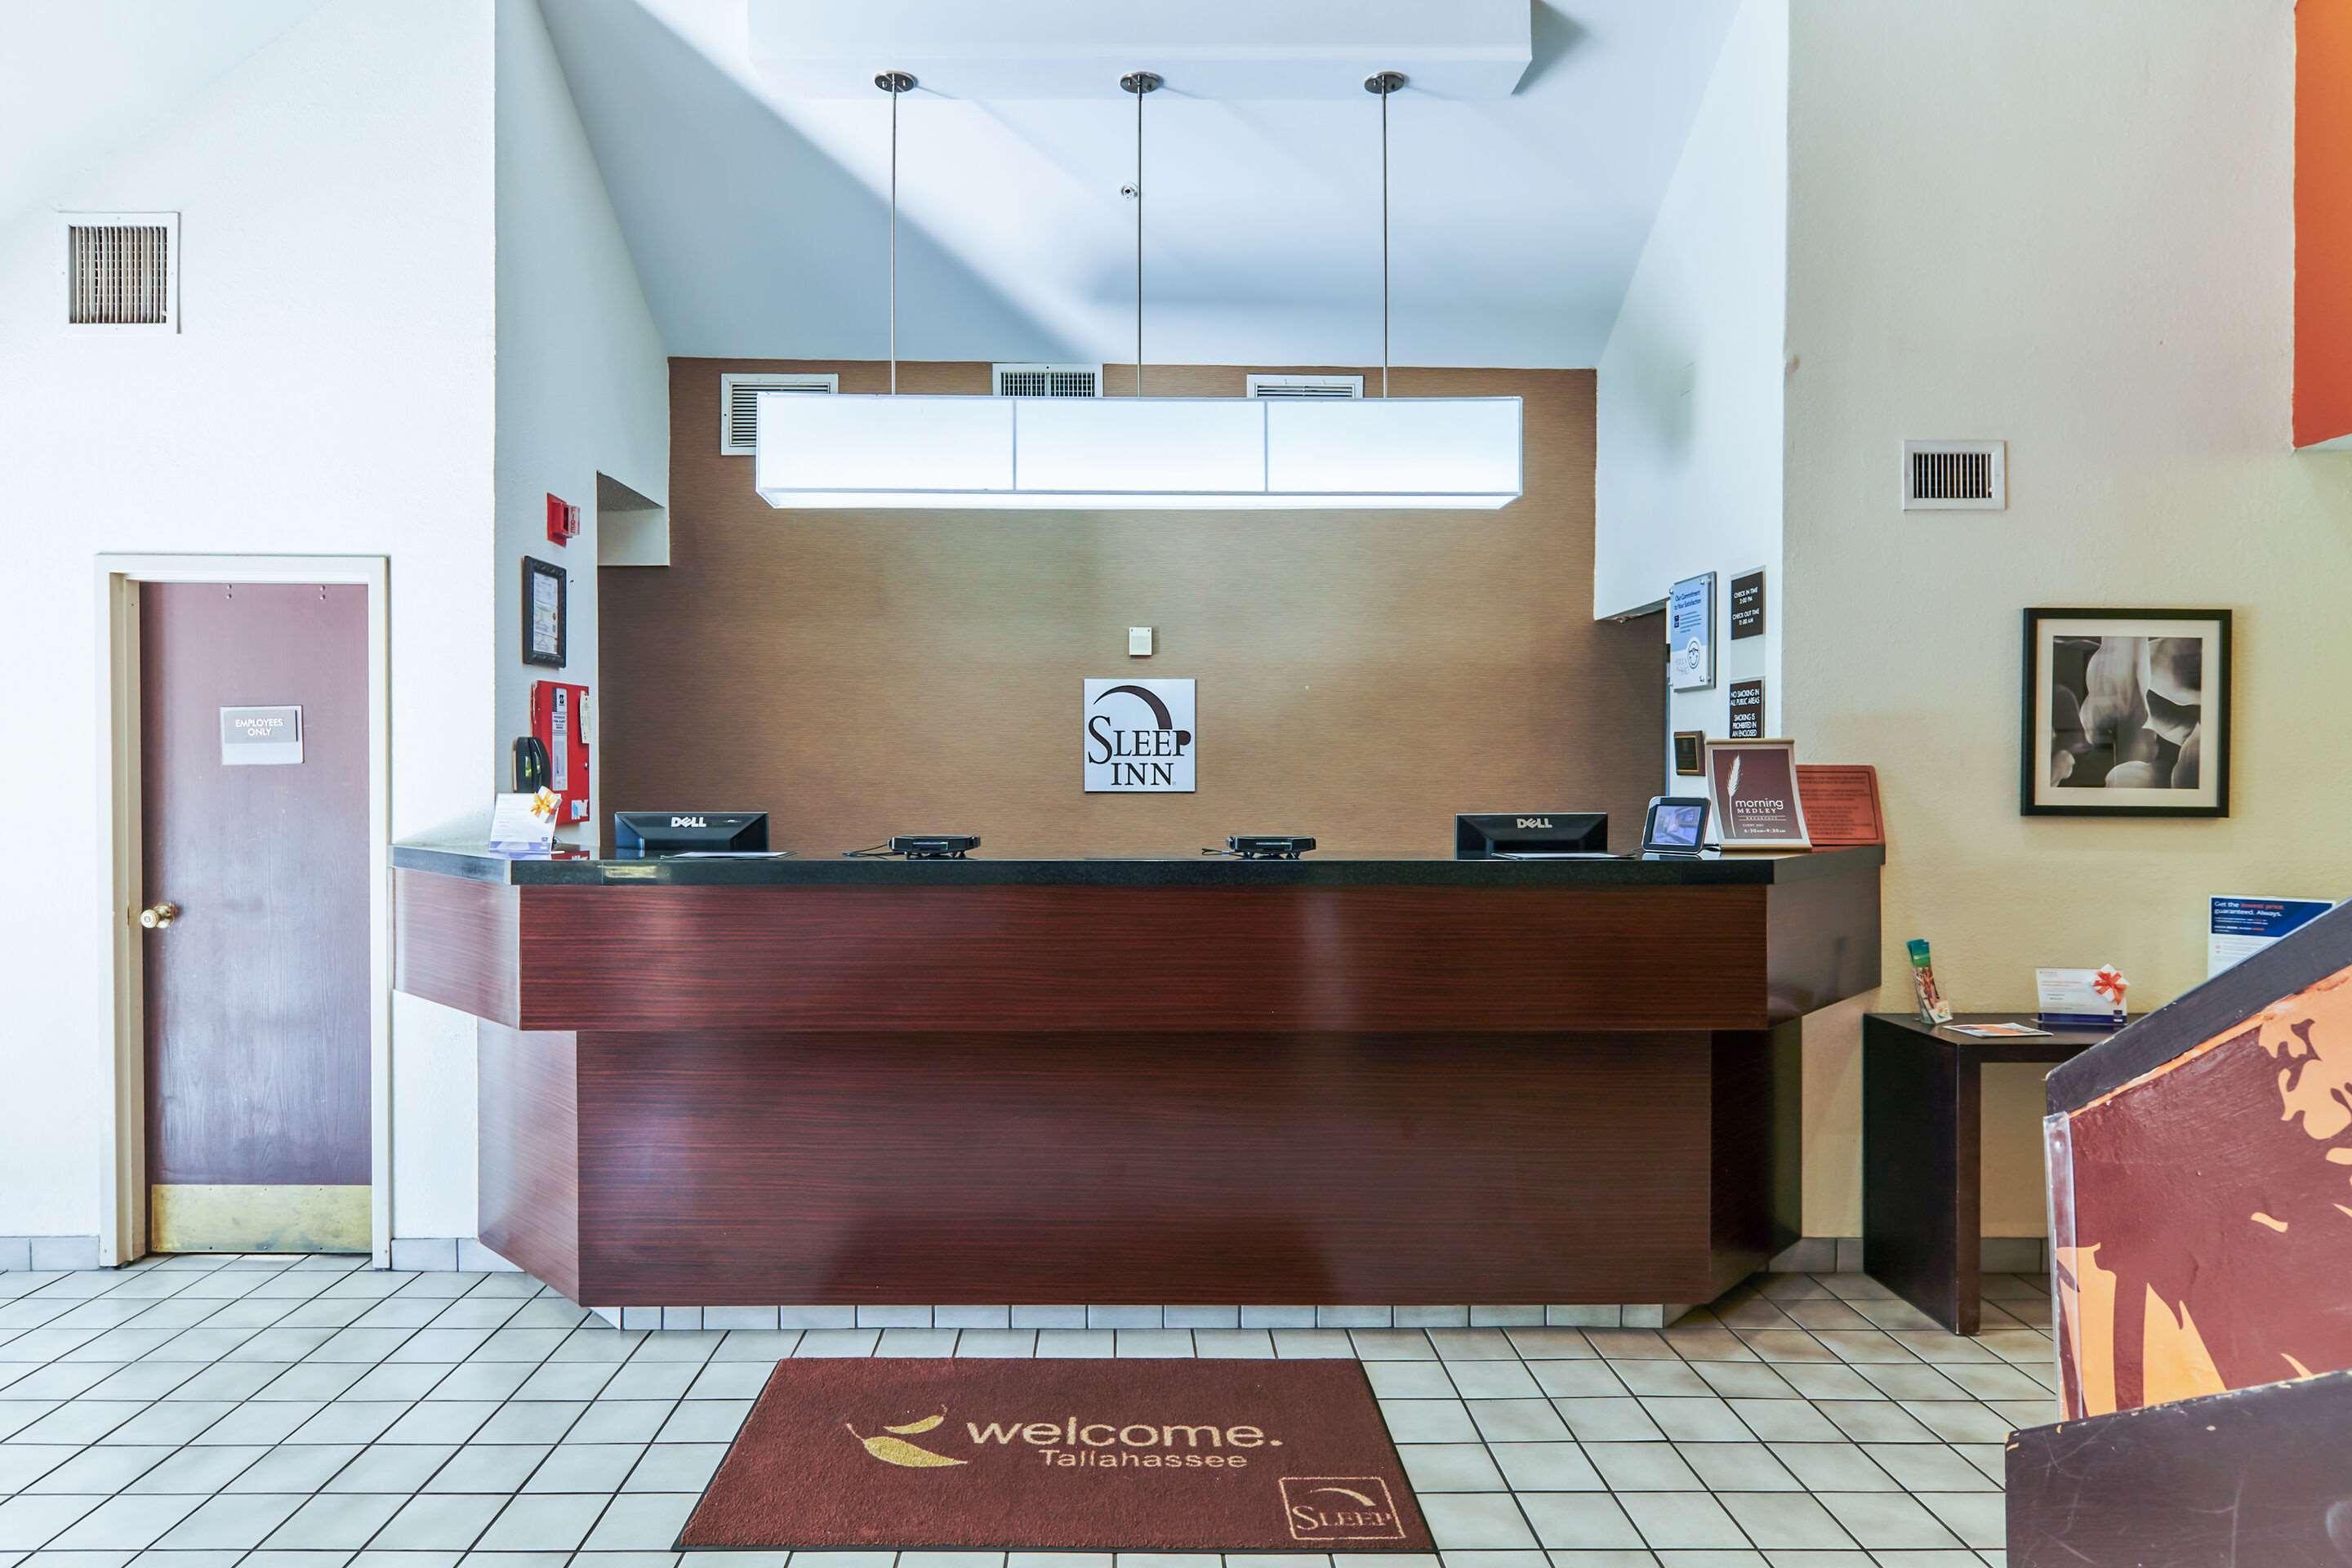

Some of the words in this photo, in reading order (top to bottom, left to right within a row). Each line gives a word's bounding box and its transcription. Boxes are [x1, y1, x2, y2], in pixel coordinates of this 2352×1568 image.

[1737, 689, 1755, 697] SMOKING
[1736, 697, 1748, 706] PUBLIC
[1748, 696, 1760, 705] AREAS
[234, 718, 283, 728] EMPLOYEES
[1734, 713, 1752, 722] SMOKING
[247, 728, 272, 737] ONLY
[1088, 715, 1192, 764] SLEEP
[1111, 763, 1174, 786] INN
[1735, 798, 1784, 809] morning
[670, 817, 706, 828] DELL
[1517, 818, 1552, 829] DELL
[2256, 910, 2283, 918] Always.
[966, 1416, 1284, 1448] welcome.
[1038, 1449, 1248, 1468] Tallahassee
[1292, 1505, 1392, 1530] SLEEP
